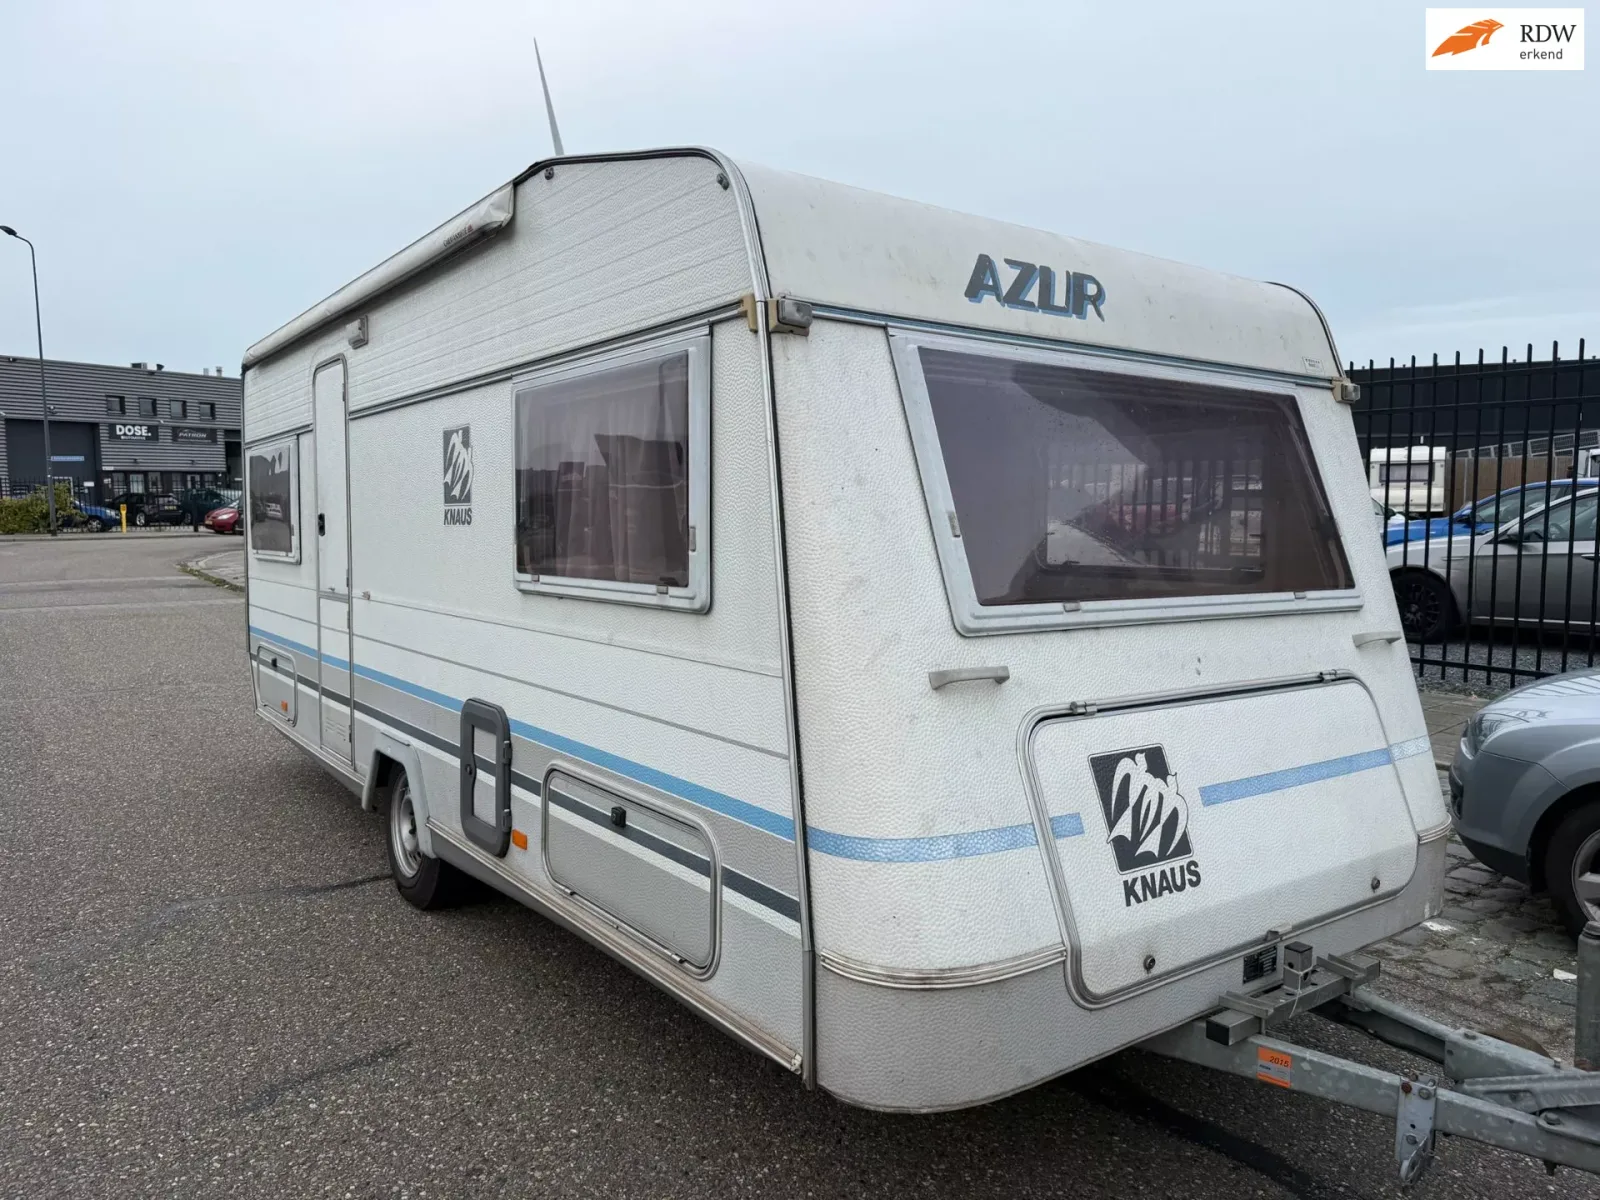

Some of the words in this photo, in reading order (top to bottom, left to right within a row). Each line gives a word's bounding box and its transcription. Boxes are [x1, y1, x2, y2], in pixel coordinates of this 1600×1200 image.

[964, 253, 1106, 322] AZUR
[116, 424, 151, 437] DOSE.
[443, 507, 473, 525] KNAUS
[1123, 860, 1201, 907] KNAUS
[1269, 1055, 1290, 1068] 2015
